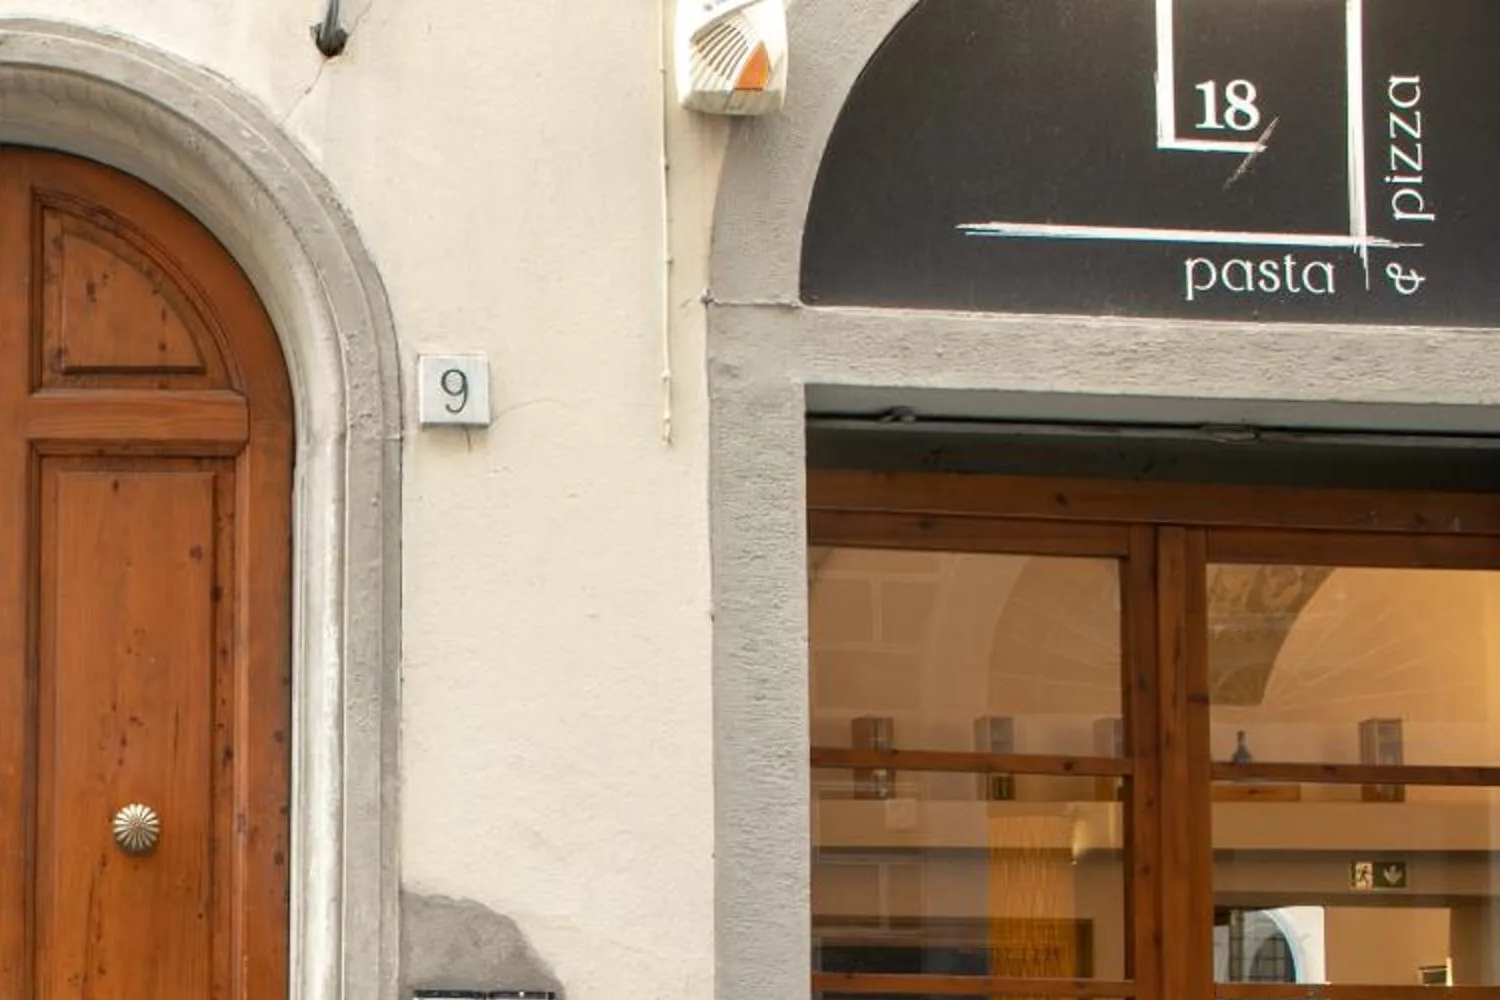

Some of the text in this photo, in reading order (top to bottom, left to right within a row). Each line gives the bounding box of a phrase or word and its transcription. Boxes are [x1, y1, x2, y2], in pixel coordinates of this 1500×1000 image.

[1194, 79, 1262, 132] 18
[1384, 74, 1437, 296] & pizza
[1183, 253, 1336, 302] pasta
[440, 368, 469, 415] 9
